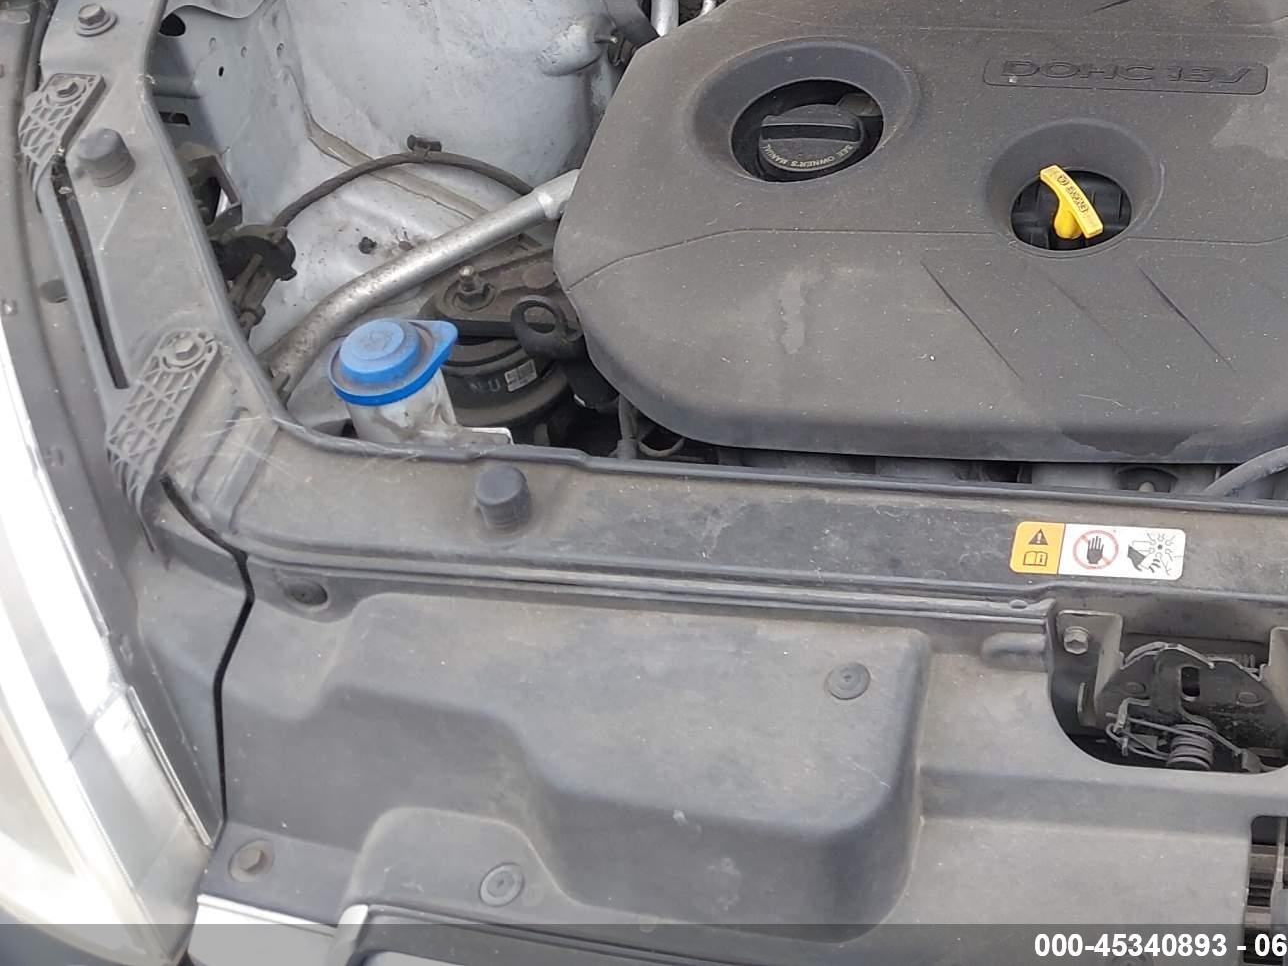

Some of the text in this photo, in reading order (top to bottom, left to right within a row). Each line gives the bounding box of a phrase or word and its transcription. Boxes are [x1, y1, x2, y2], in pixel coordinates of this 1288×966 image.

[1000, 60, 1155, 81] DOHC
[760, 143, 855, 169] SEE OWNER'S MANUAL
